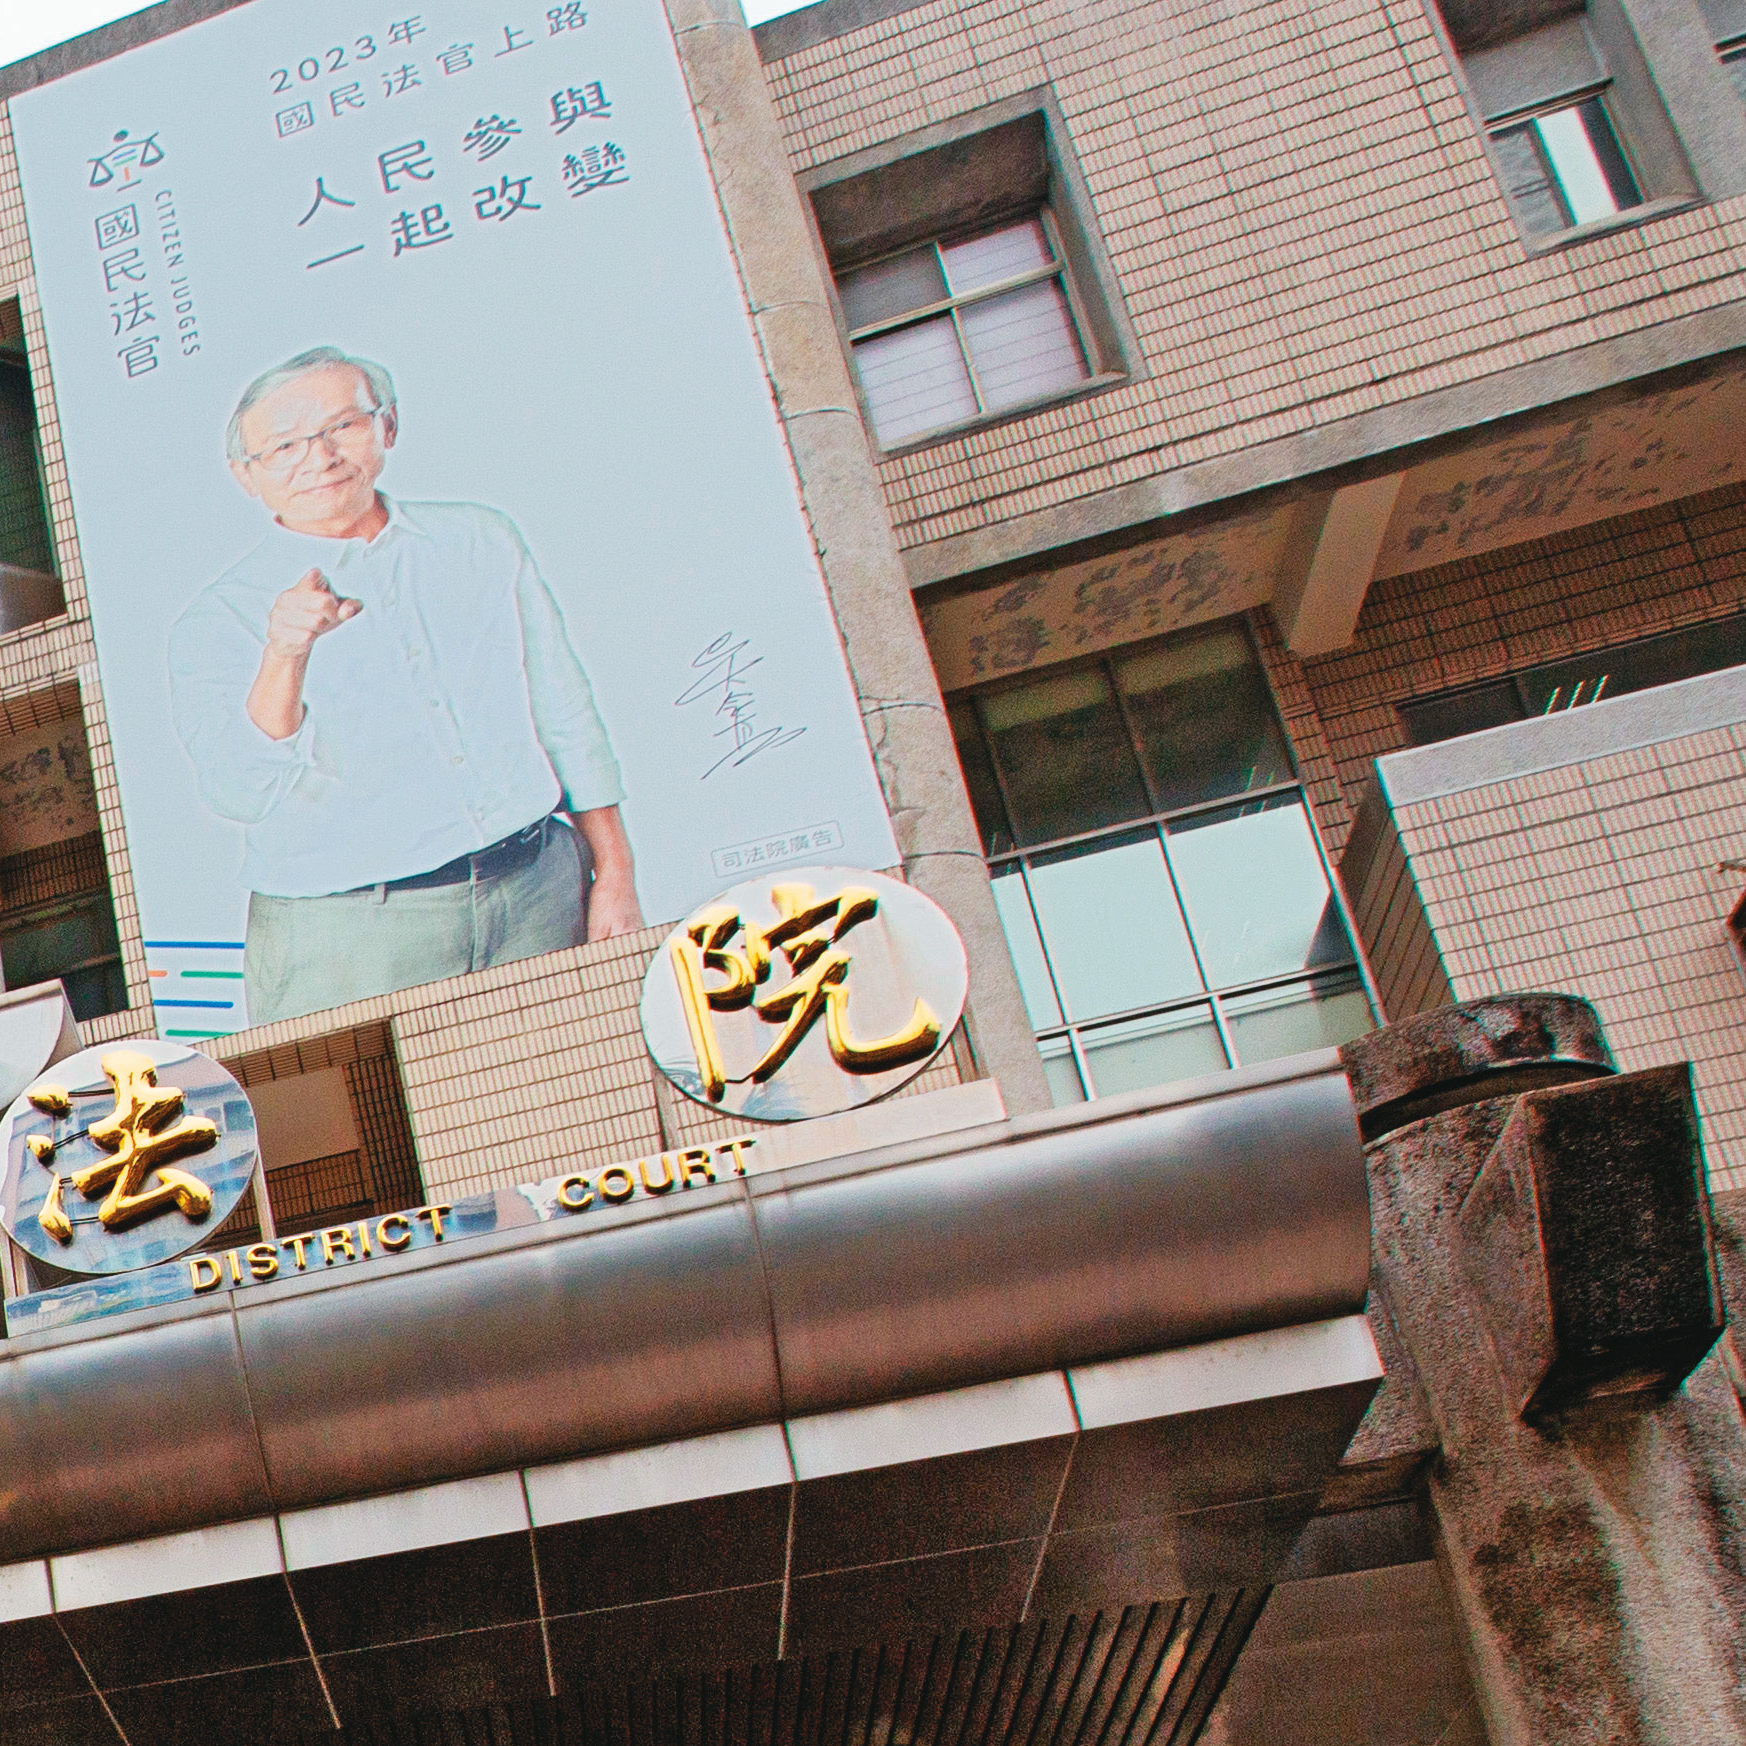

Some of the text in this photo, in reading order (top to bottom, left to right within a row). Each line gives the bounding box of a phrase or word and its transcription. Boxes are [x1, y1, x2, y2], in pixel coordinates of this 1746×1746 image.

[269, 15, 426, 94] 2023年
[275, 1, 588, 138] 國民法官上路
[297, 80, 612, 227] 人民參與
[306, 142, 630, 269] 一起改變
[94, 203, 159, 378] 國民法官
[155, 189, 201, 356] CITIZEN JUDGES
[722, 829, 833, 867] 司法院廣告
[188, 1138, 755, 1293] DISTRICT COURT
